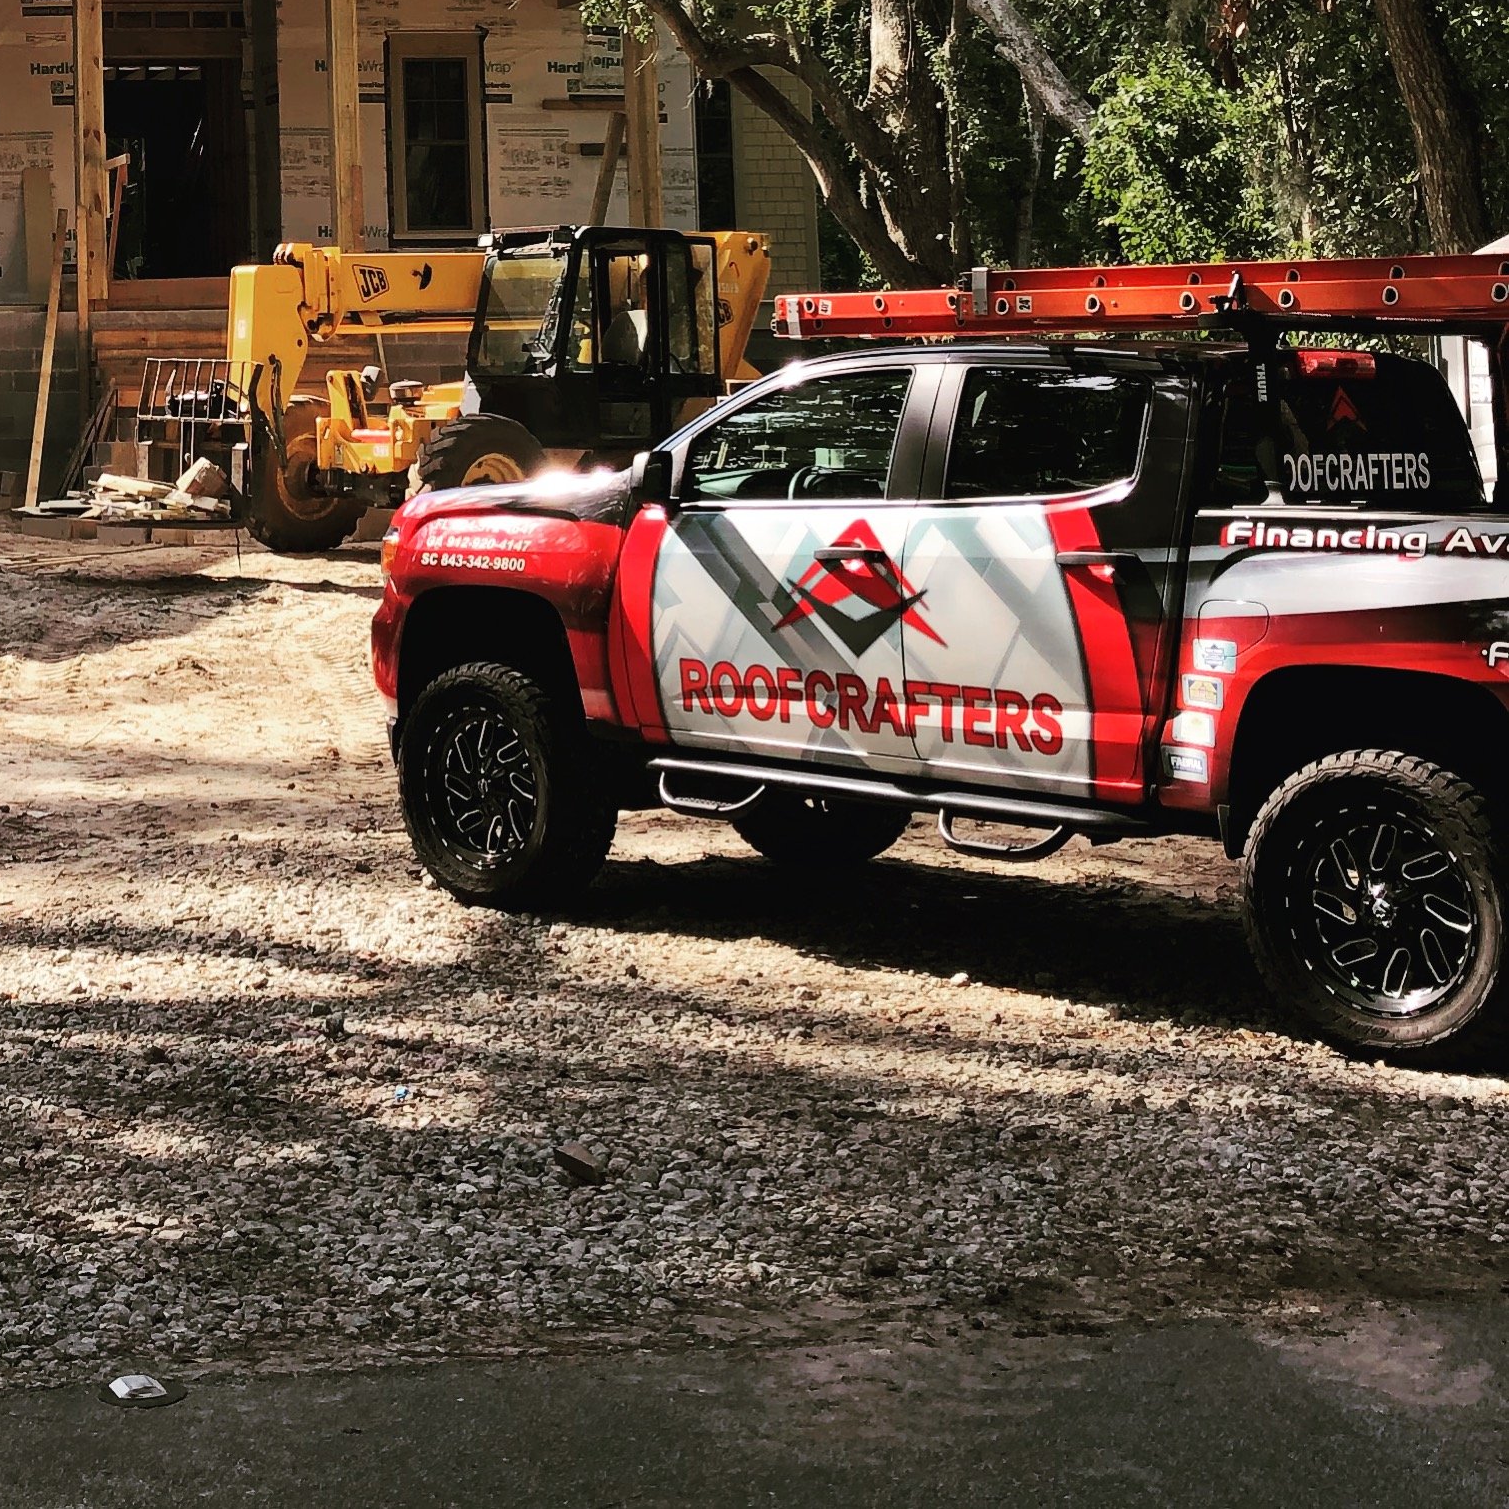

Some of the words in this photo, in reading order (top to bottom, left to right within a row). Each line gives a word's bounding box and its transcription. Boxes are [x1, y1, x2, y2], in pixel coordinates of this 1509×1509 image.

[358, 268, 387, 298] JCB
[1256, 363, 1268, 402] THULE
[447, 535, 532, 551] 912-920-4147
[1224, 521, 1428, 558] Financing
[1444, 526, 1509, 555] Av
[421, 552, 438, 566] SC
[440, 552, 526, 572] 843-342-9800
[679, 657, 1064, 756] ROOFCRAFTERS
